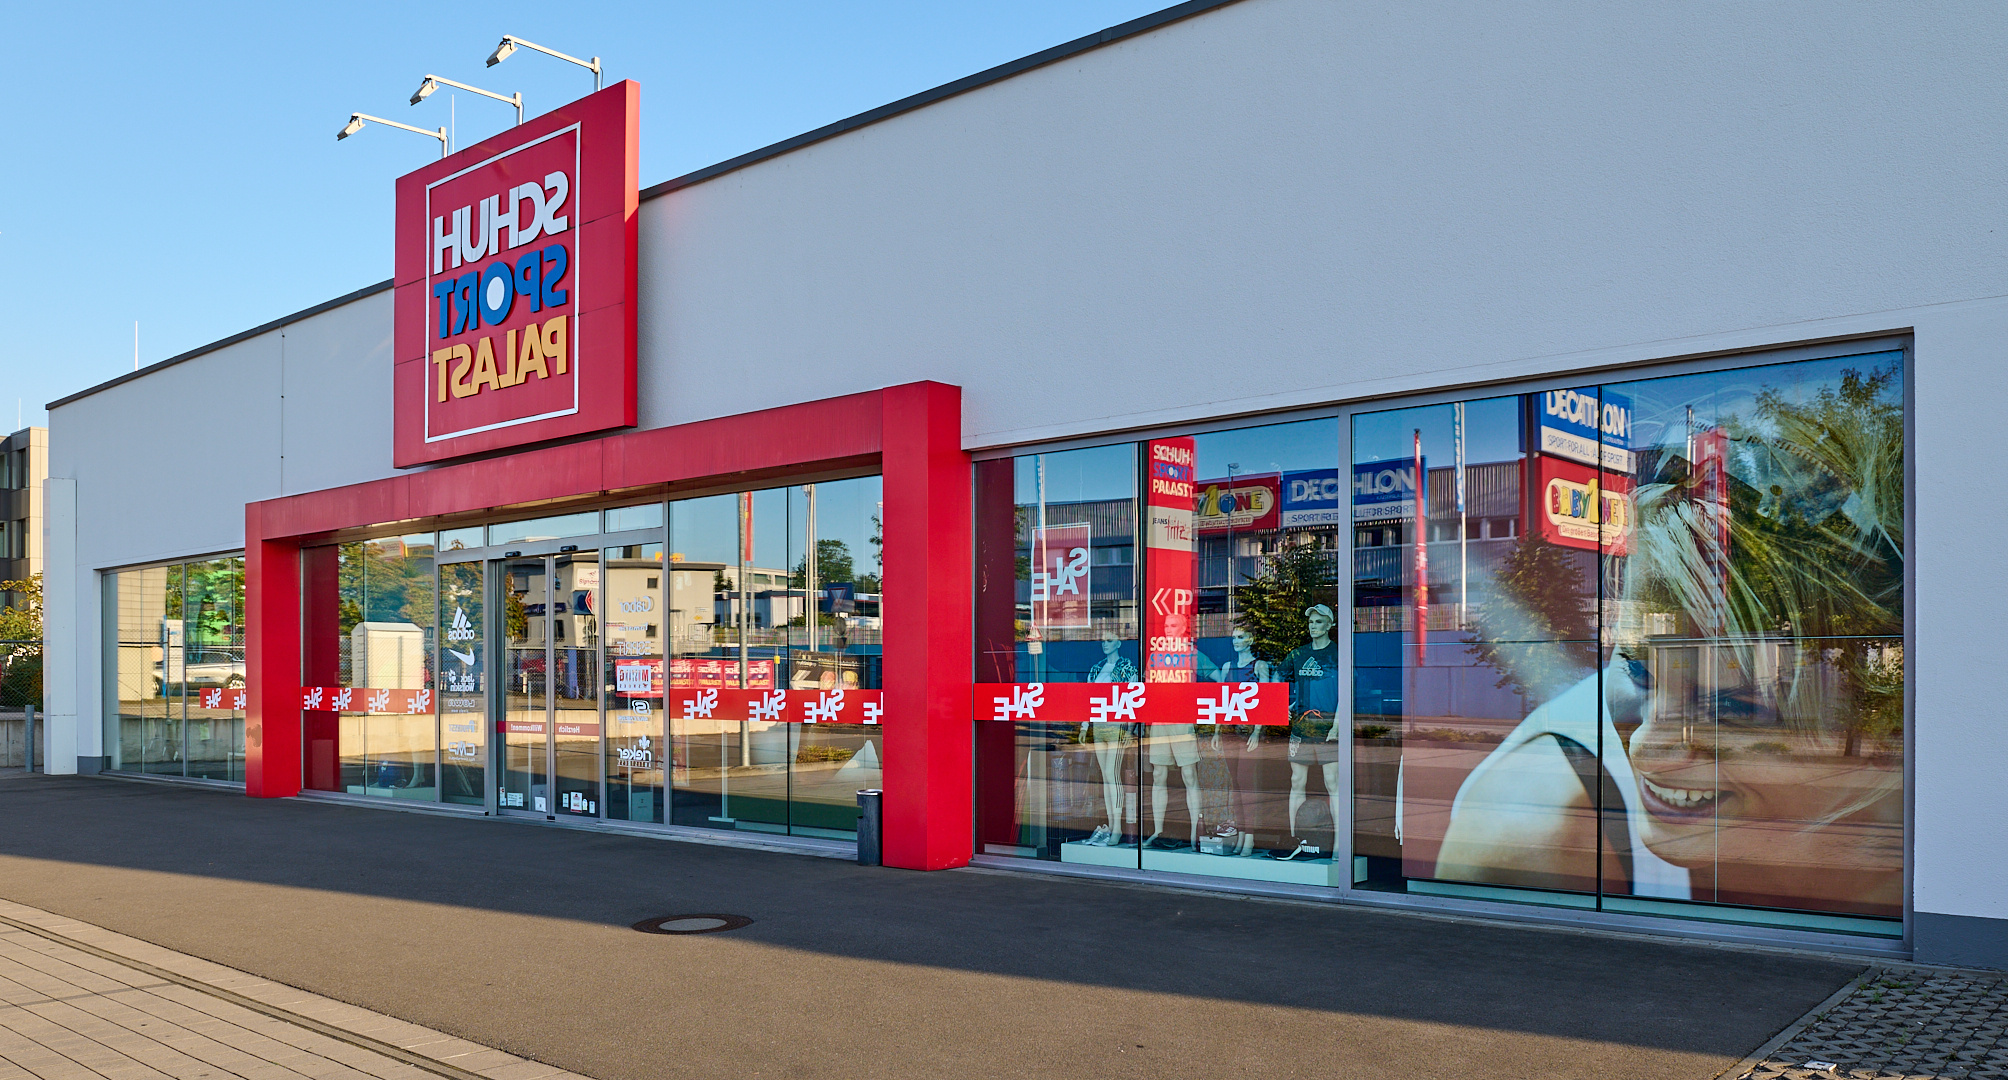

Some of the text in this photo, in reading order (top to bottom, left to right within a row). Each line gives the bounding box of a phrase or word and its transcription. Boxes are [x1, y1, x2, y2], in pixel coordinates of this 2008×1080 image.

[1153, 444, 1193, 466] SCHUH
[1153, 462, 1193, 482] SPORT
[1152, 479, 1193, 498] PALAST
[1149, 637, 1193, 652] SCHUH
